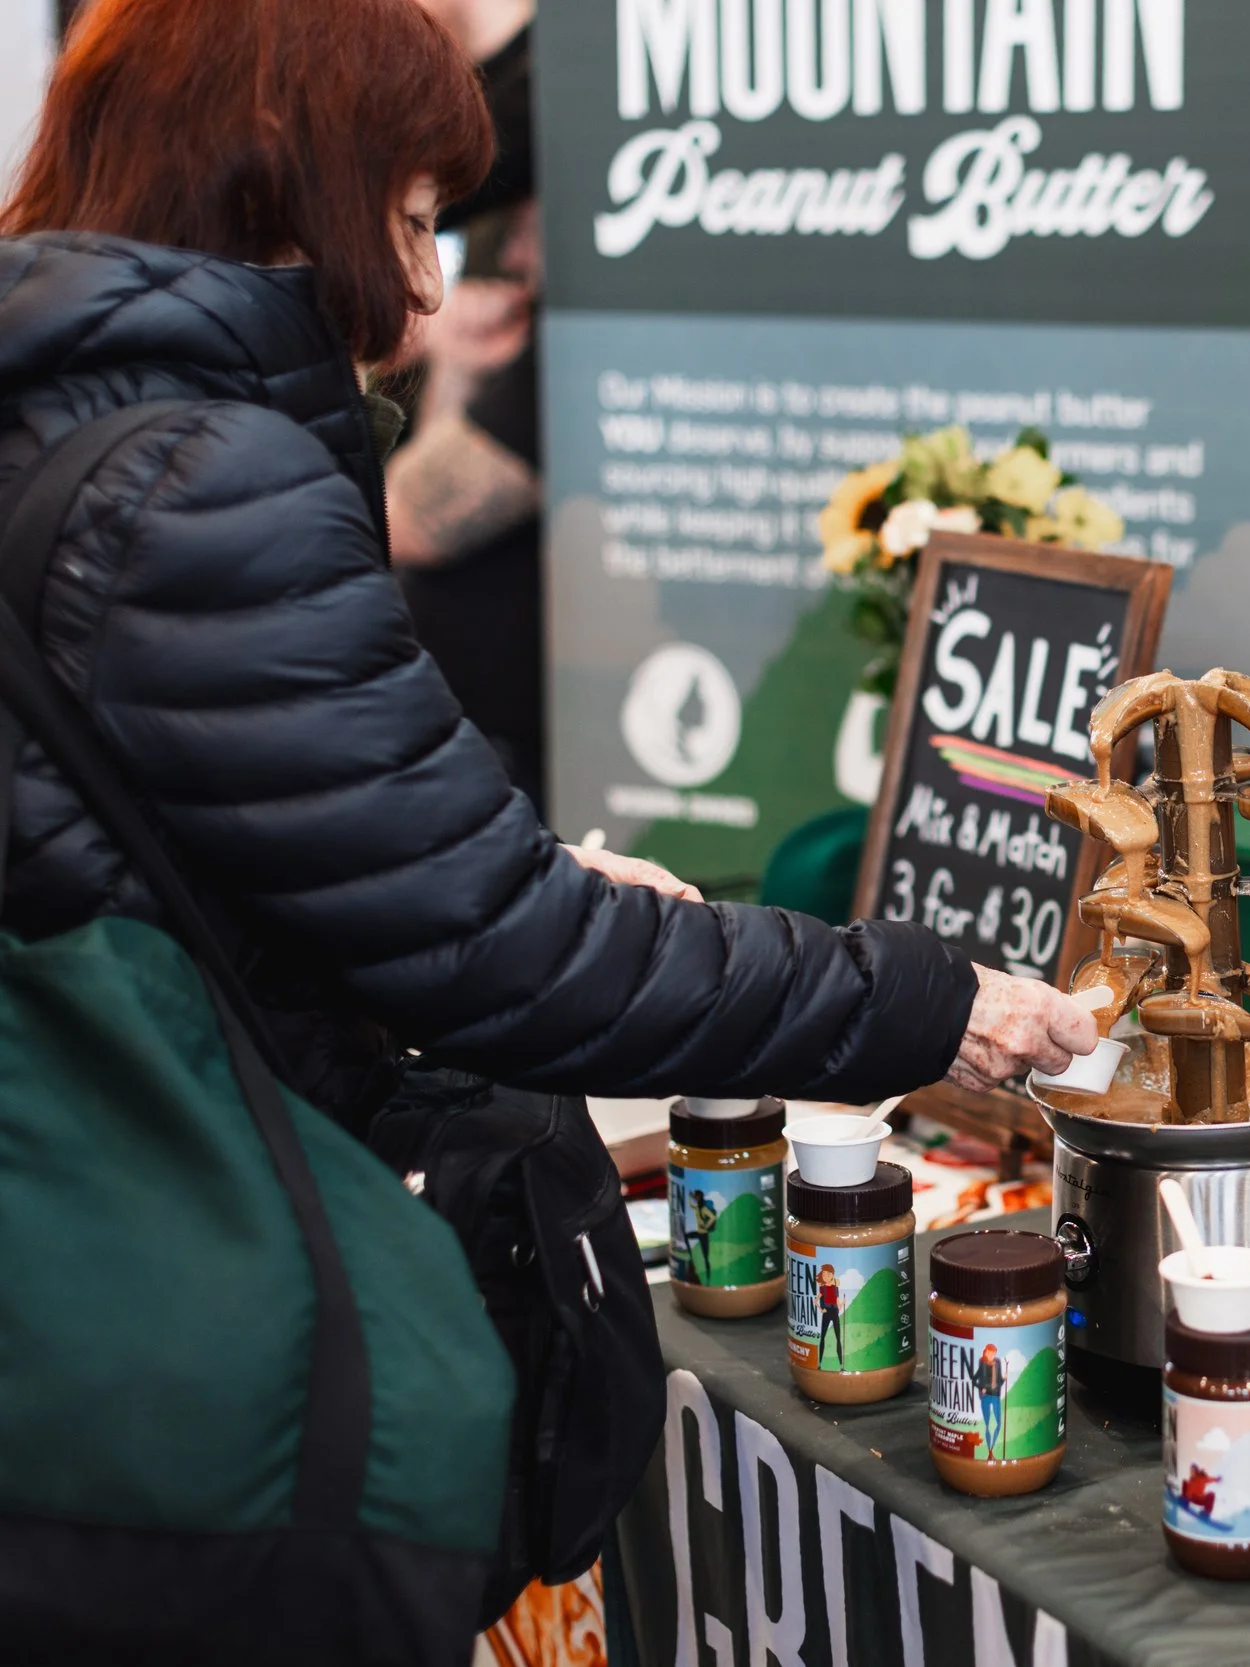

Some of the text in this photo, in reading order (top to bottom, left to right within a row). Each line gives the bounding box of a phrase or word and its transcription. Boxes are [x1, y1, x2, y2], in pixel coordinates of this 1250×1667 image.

[594, 114, 1213, 260] Peanut Butter
[922, 608, 1102, 761] SALE
[895, 783, 954, 847] Mix
[979, 810, 1068, 880] Match
[885, 858, 916, 921] 3
[923, 867, 974, 937] for
[929, 1333, 974, 1381] REEN
[946, 1411, 979, 1426] Butter
